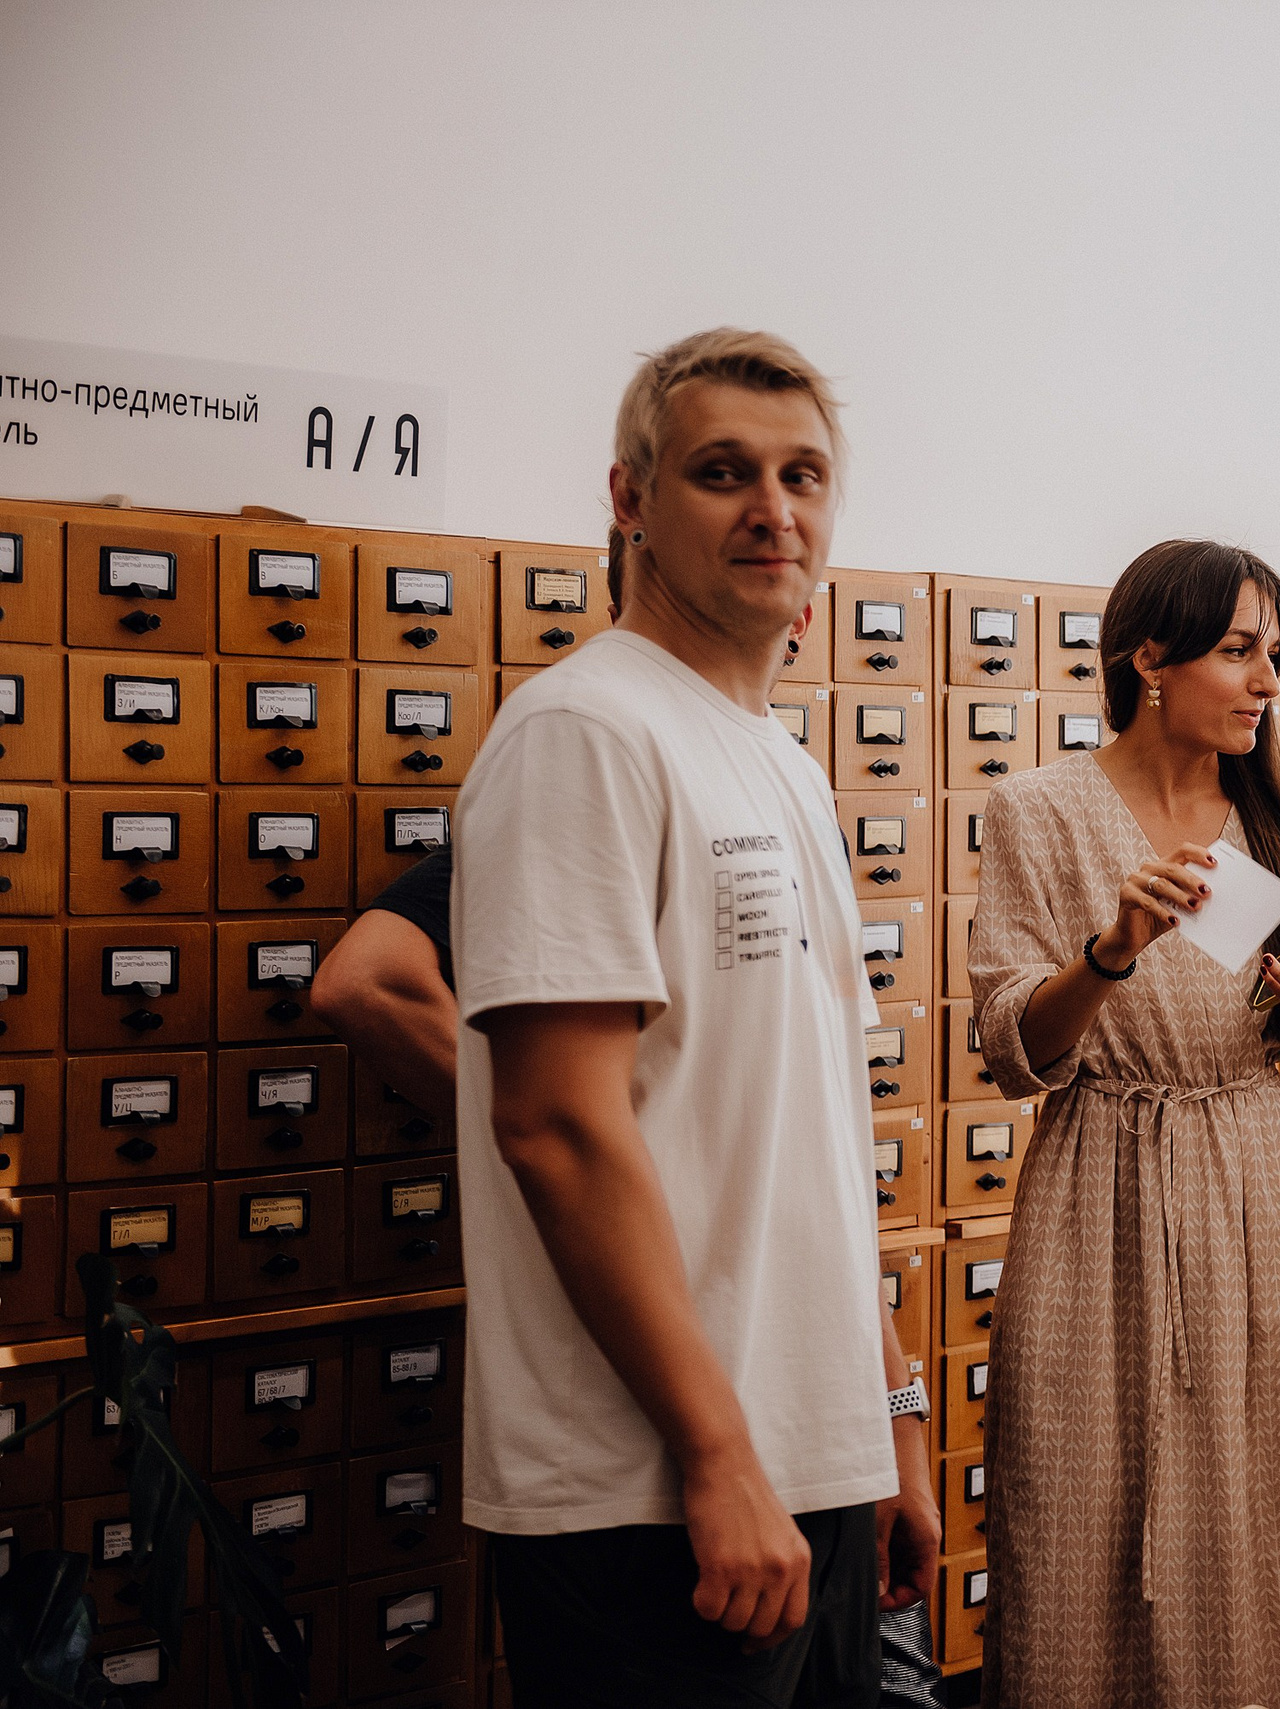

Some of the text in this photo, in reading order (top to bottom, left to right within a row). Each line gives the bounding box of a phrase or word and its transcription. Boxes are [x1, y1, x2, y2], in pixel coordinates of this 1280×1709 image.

[0, 374, 259, 423] тно-предметный
[0, 421, 38, 445] ль
[112, 570, 118, 580] Б
[115, 835, 121, 844] Н
